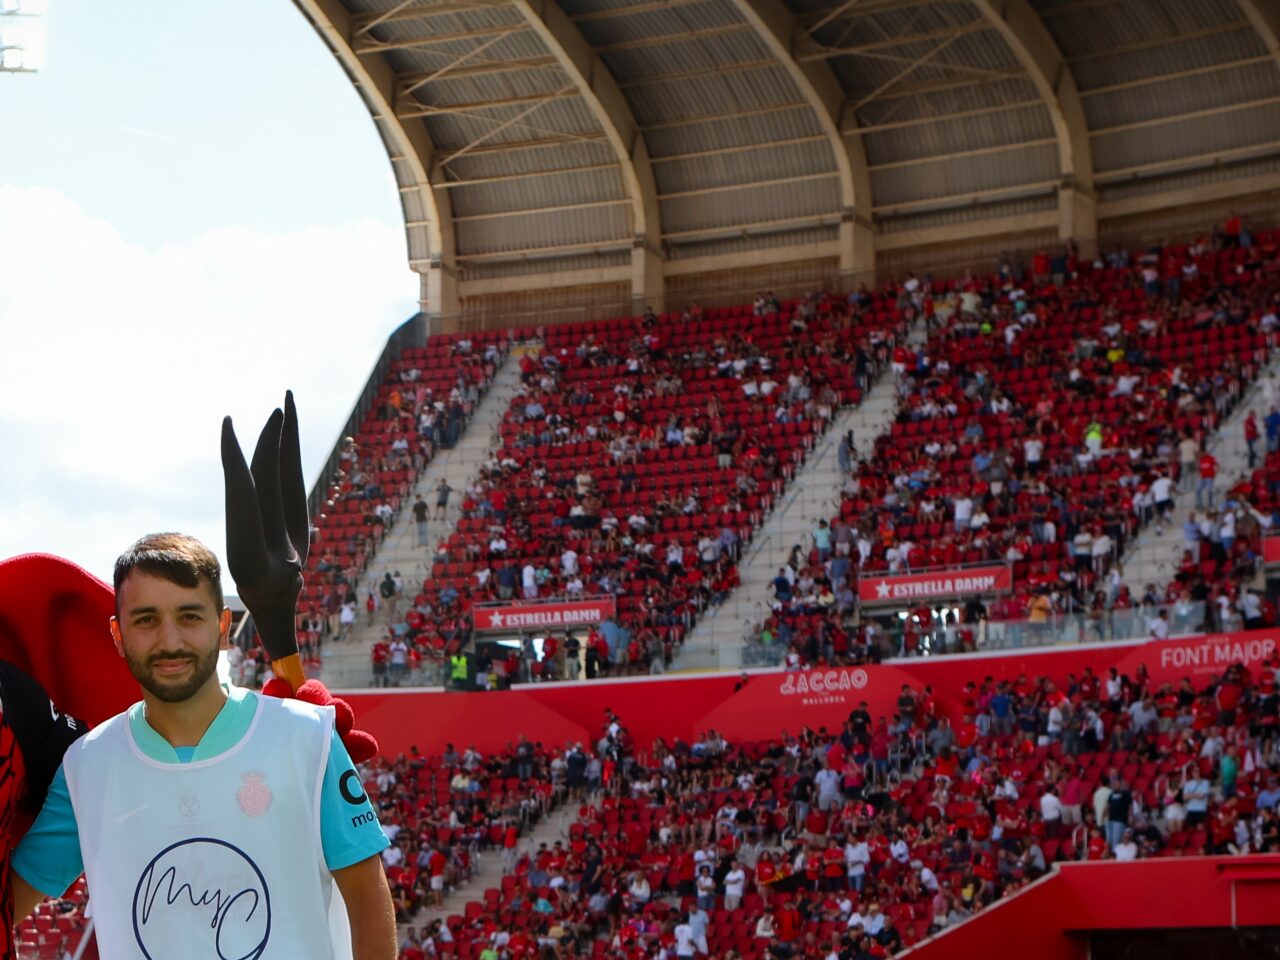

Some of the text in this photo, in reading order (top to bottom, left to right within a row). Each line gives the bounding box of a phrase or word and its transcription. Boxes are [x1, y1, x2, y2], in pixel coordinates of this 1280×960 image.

[893, 575, 996, 597] ESTRELLA DAMM
[506, 608, 600, 626] ESTRELLA DAMM
[1161, 638, 1276, 669] FONT MAJOR
[351, 811, 375, 828] mo
